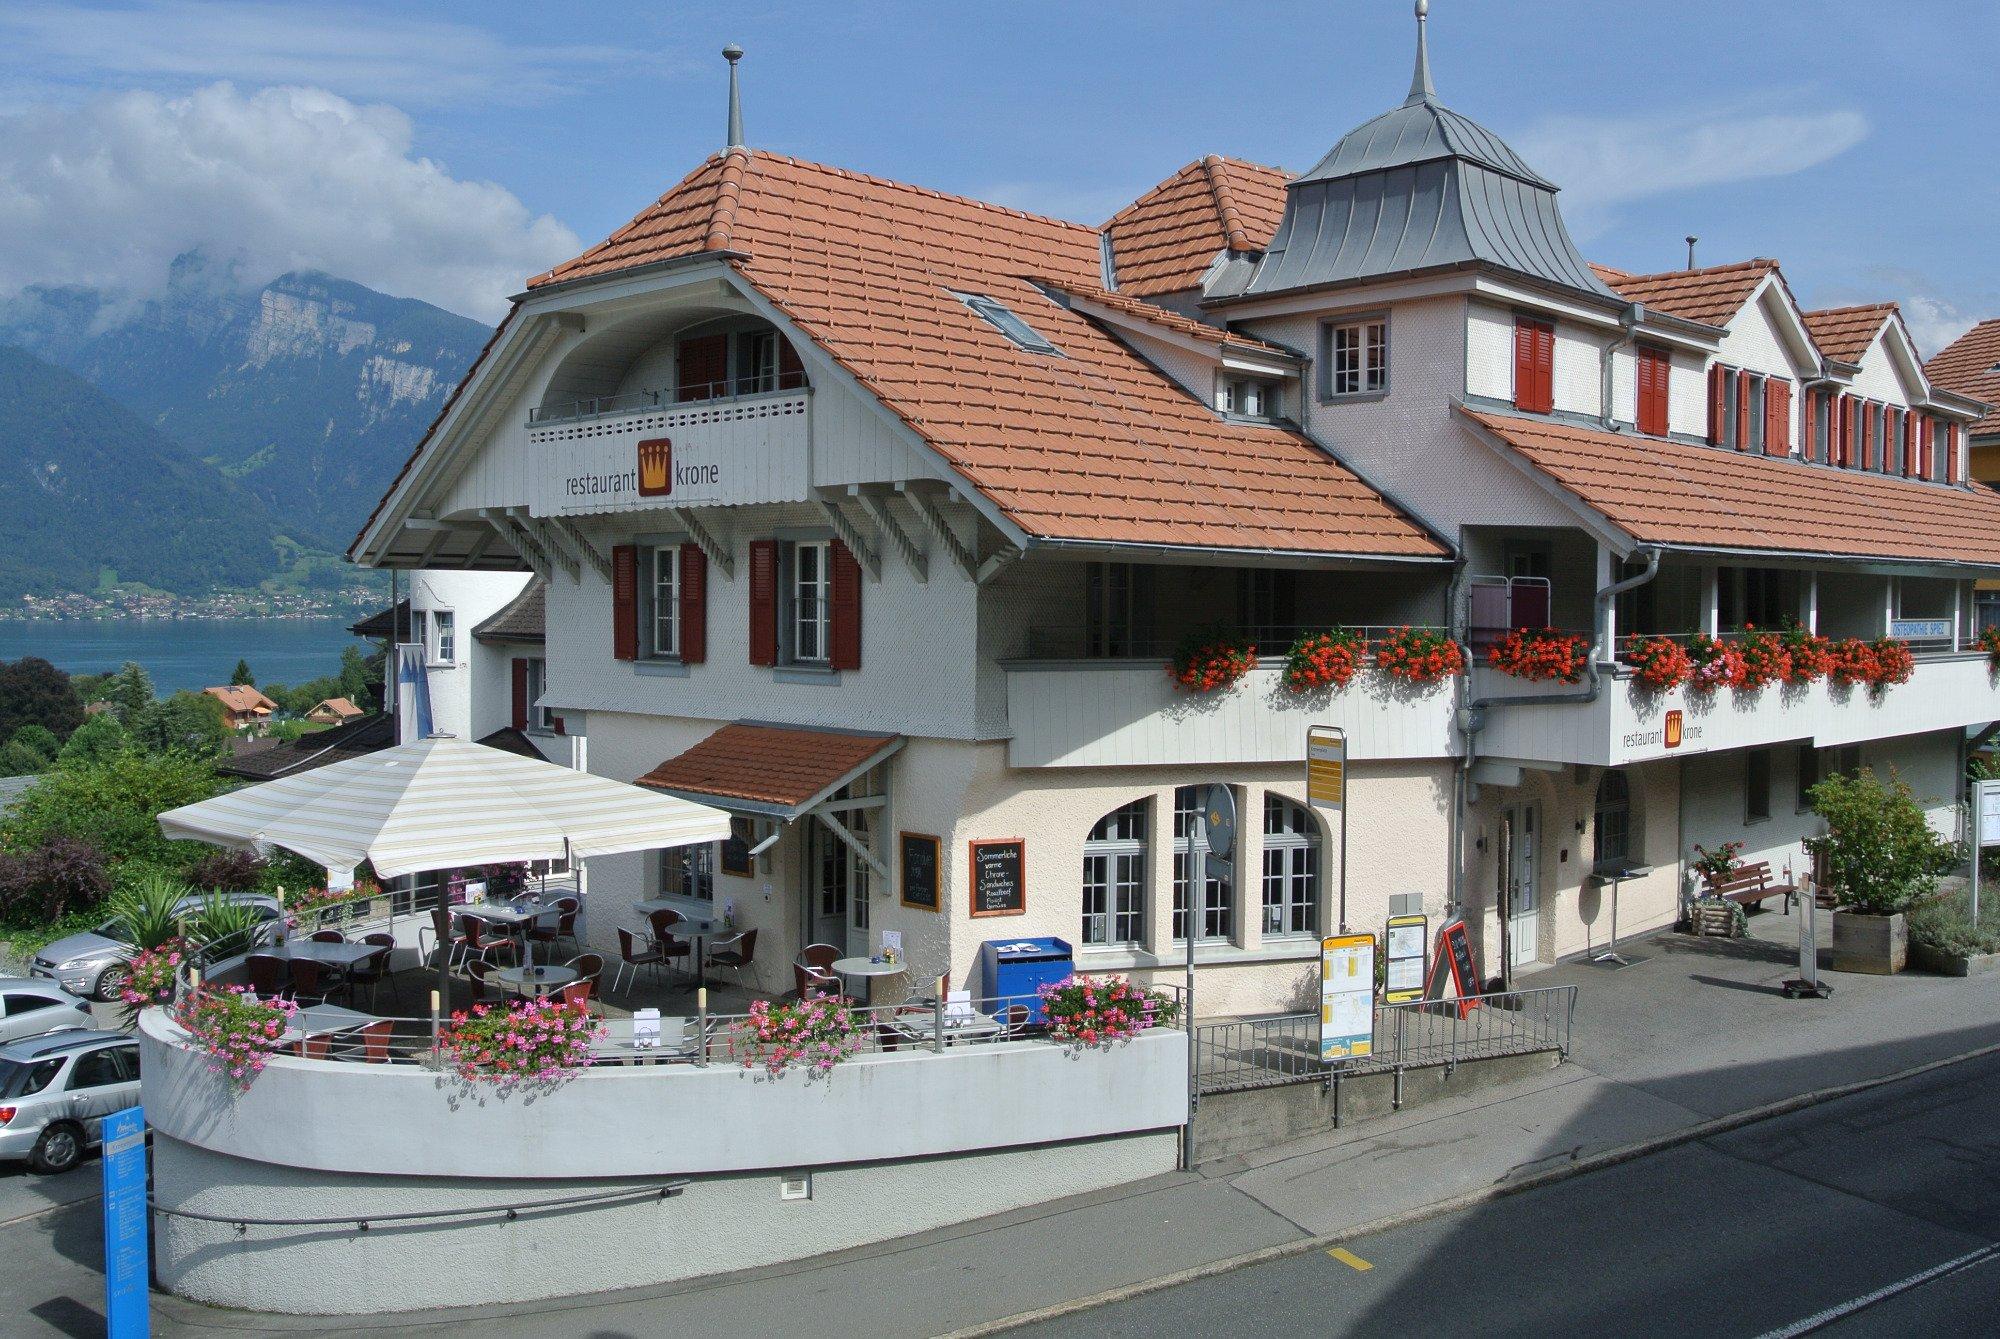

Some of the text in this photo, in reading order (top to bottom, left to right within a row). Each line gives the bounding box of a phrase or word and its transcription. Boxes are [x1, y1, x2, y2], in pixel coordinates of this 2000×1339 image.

[566, 460, 719, 496] restaurant krone
[1893, 622, 1944, 636] OSTEOPATHIE SPIEZ
[1623, 723, 1703, 748] restaurant krone
